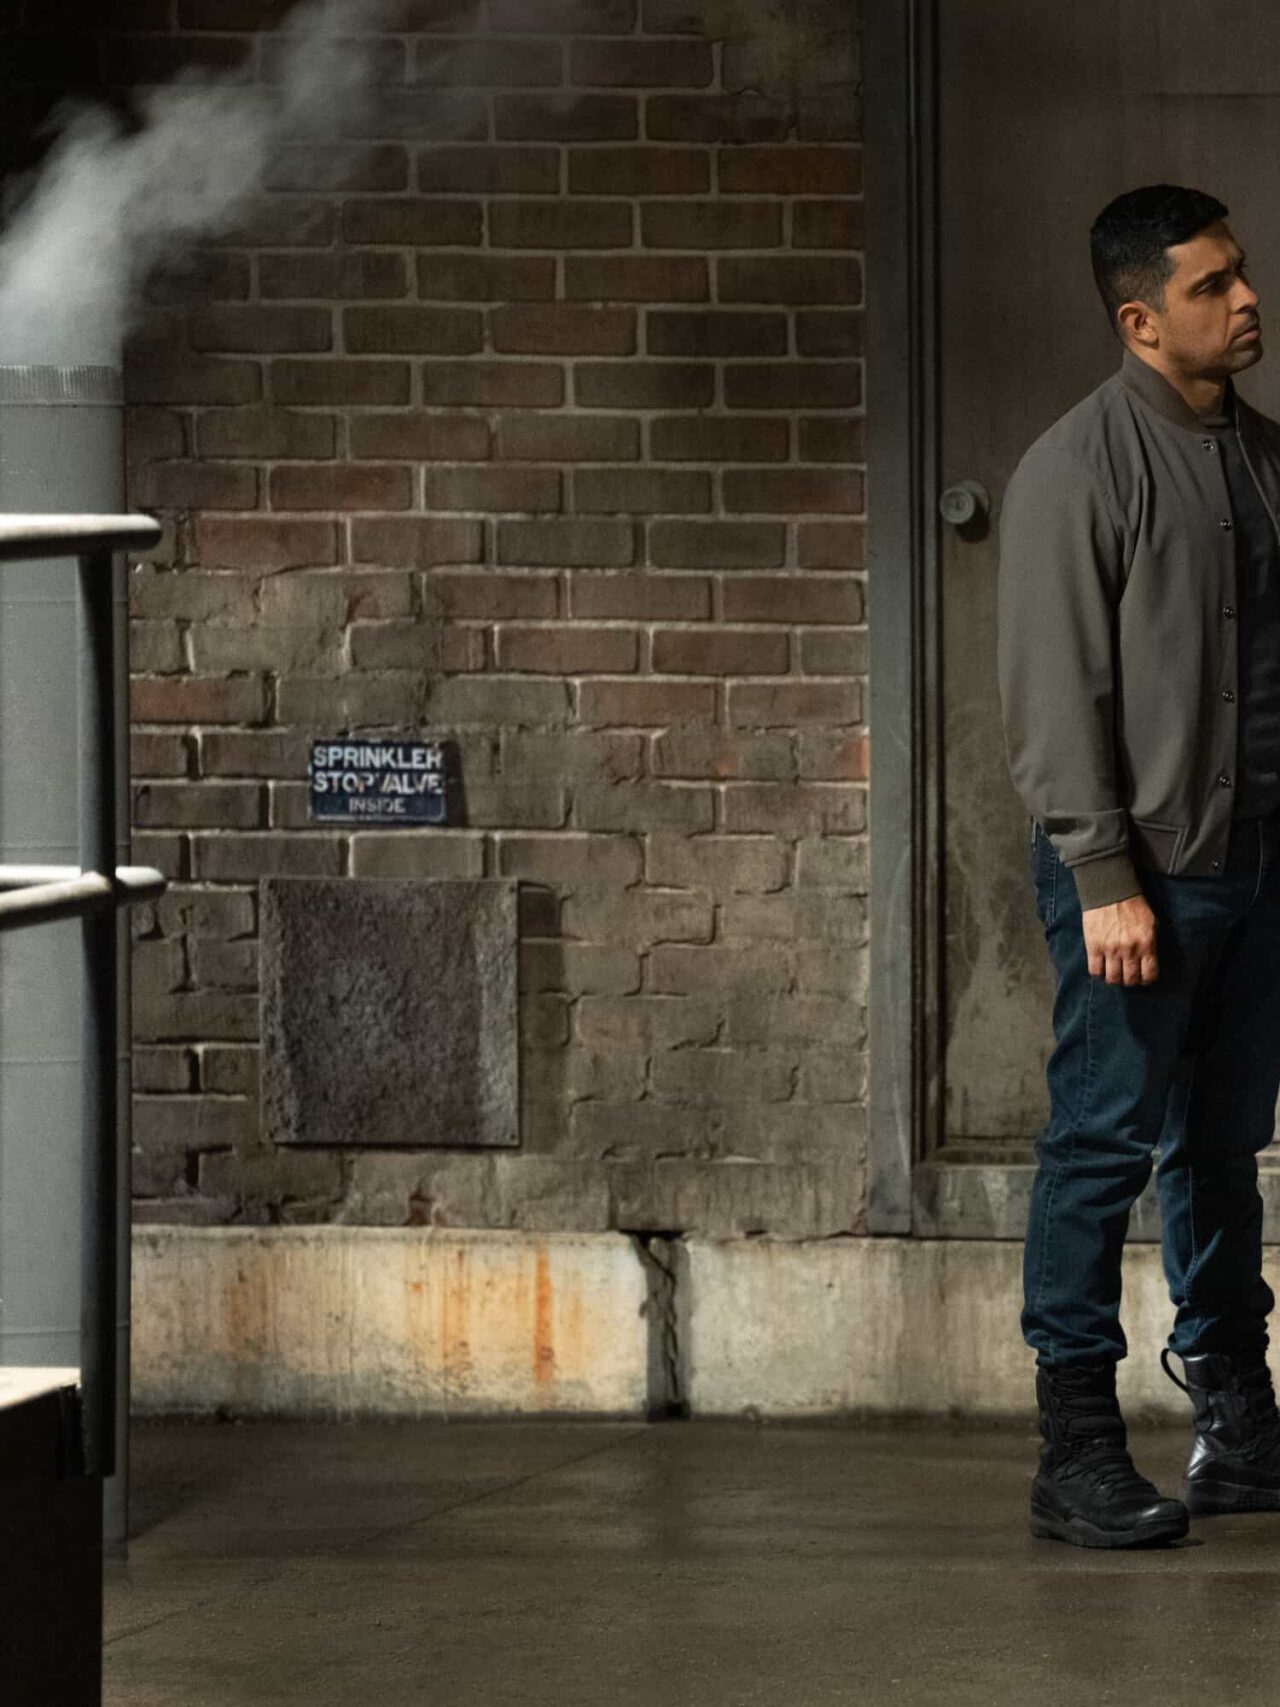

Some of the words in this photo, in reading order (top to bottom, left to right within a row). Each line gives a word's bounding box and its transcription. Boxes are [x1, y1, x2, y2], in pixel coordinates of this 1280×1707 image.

[313, 746, 443, 769] SPRINKLER
[313, 771, 375, 793] STOP
[349, 797, 406, 813] INSIDE
